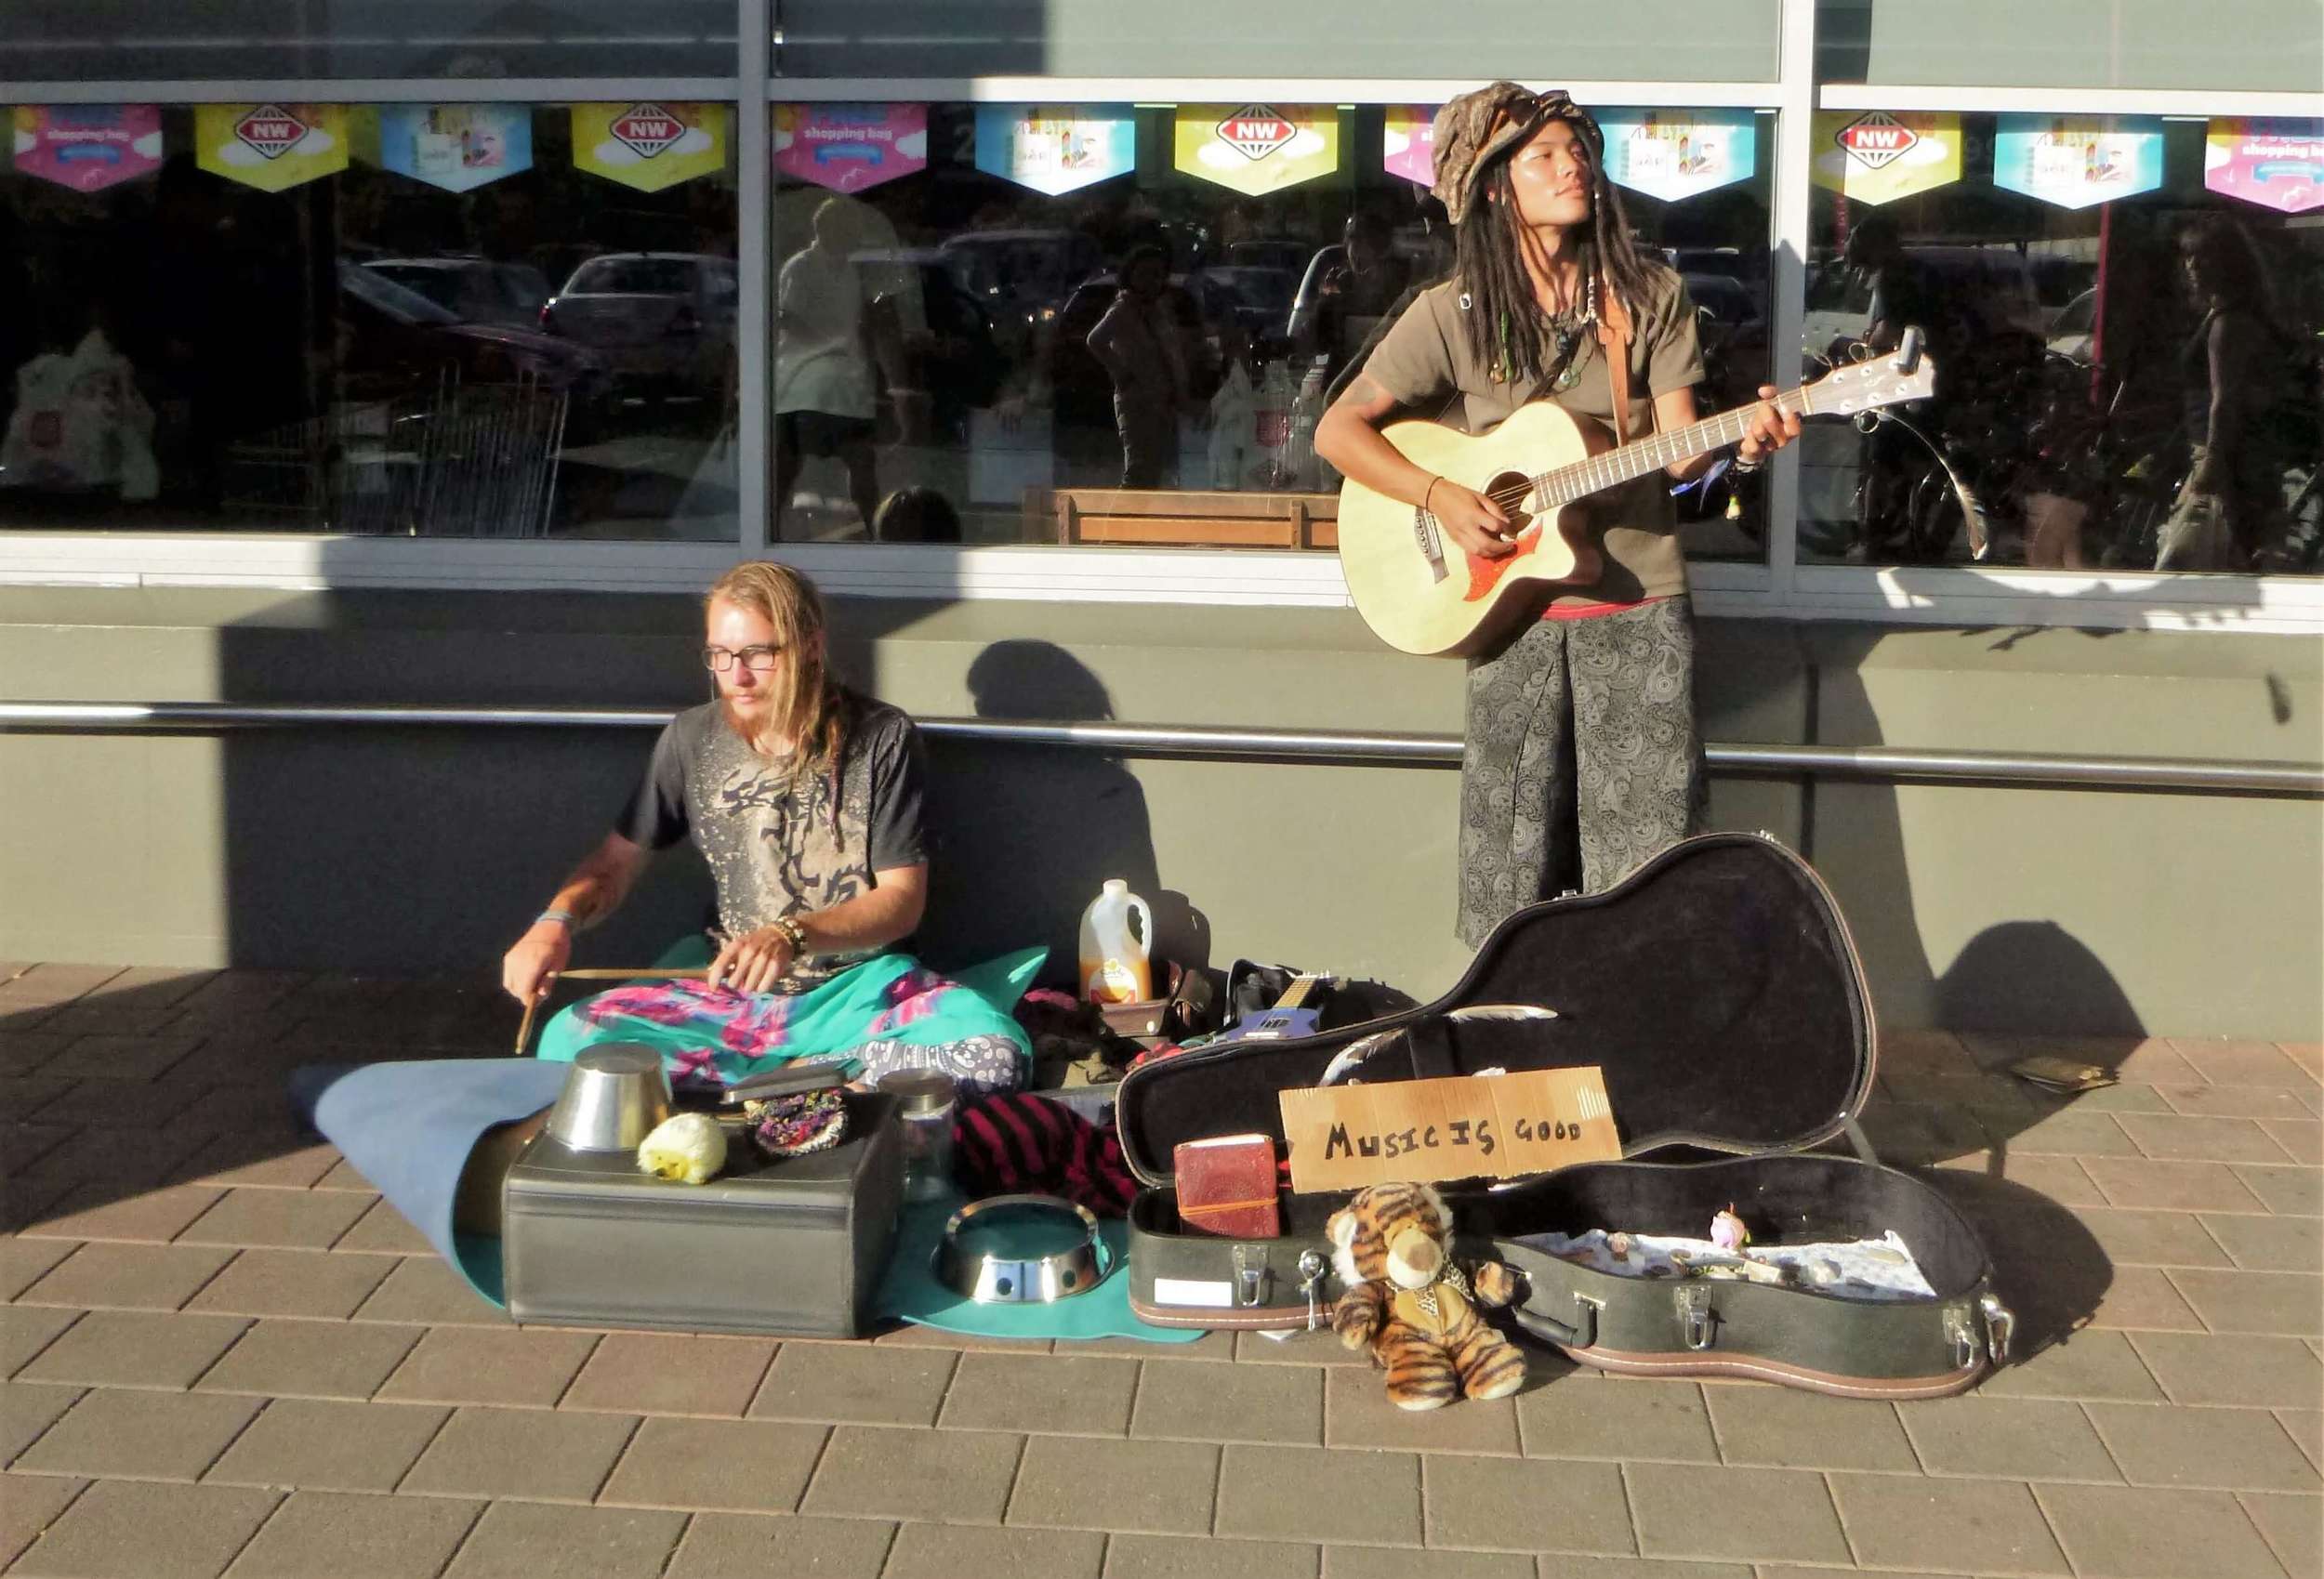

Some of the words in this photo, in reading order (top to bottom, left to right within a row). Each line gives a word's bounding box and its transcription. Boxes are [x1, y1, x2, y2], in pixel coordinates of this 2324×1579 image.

[252, 123, 290, 138] NW
[629, 121, 668, 138] NW
[803, 126, 865, 141] shopping
[867, 126, 893, 141] bag
[1236, 122, 1279, 139] NW
[1855, 130, 1900, 148] NW
[2242, 142, 2308, 159] shopping
[1325, 1122, 1440, 1160] MUSIC
[1449, 1119, 1496, 1155] IS
[1514, 1118, 1581, 1142] GOOD
